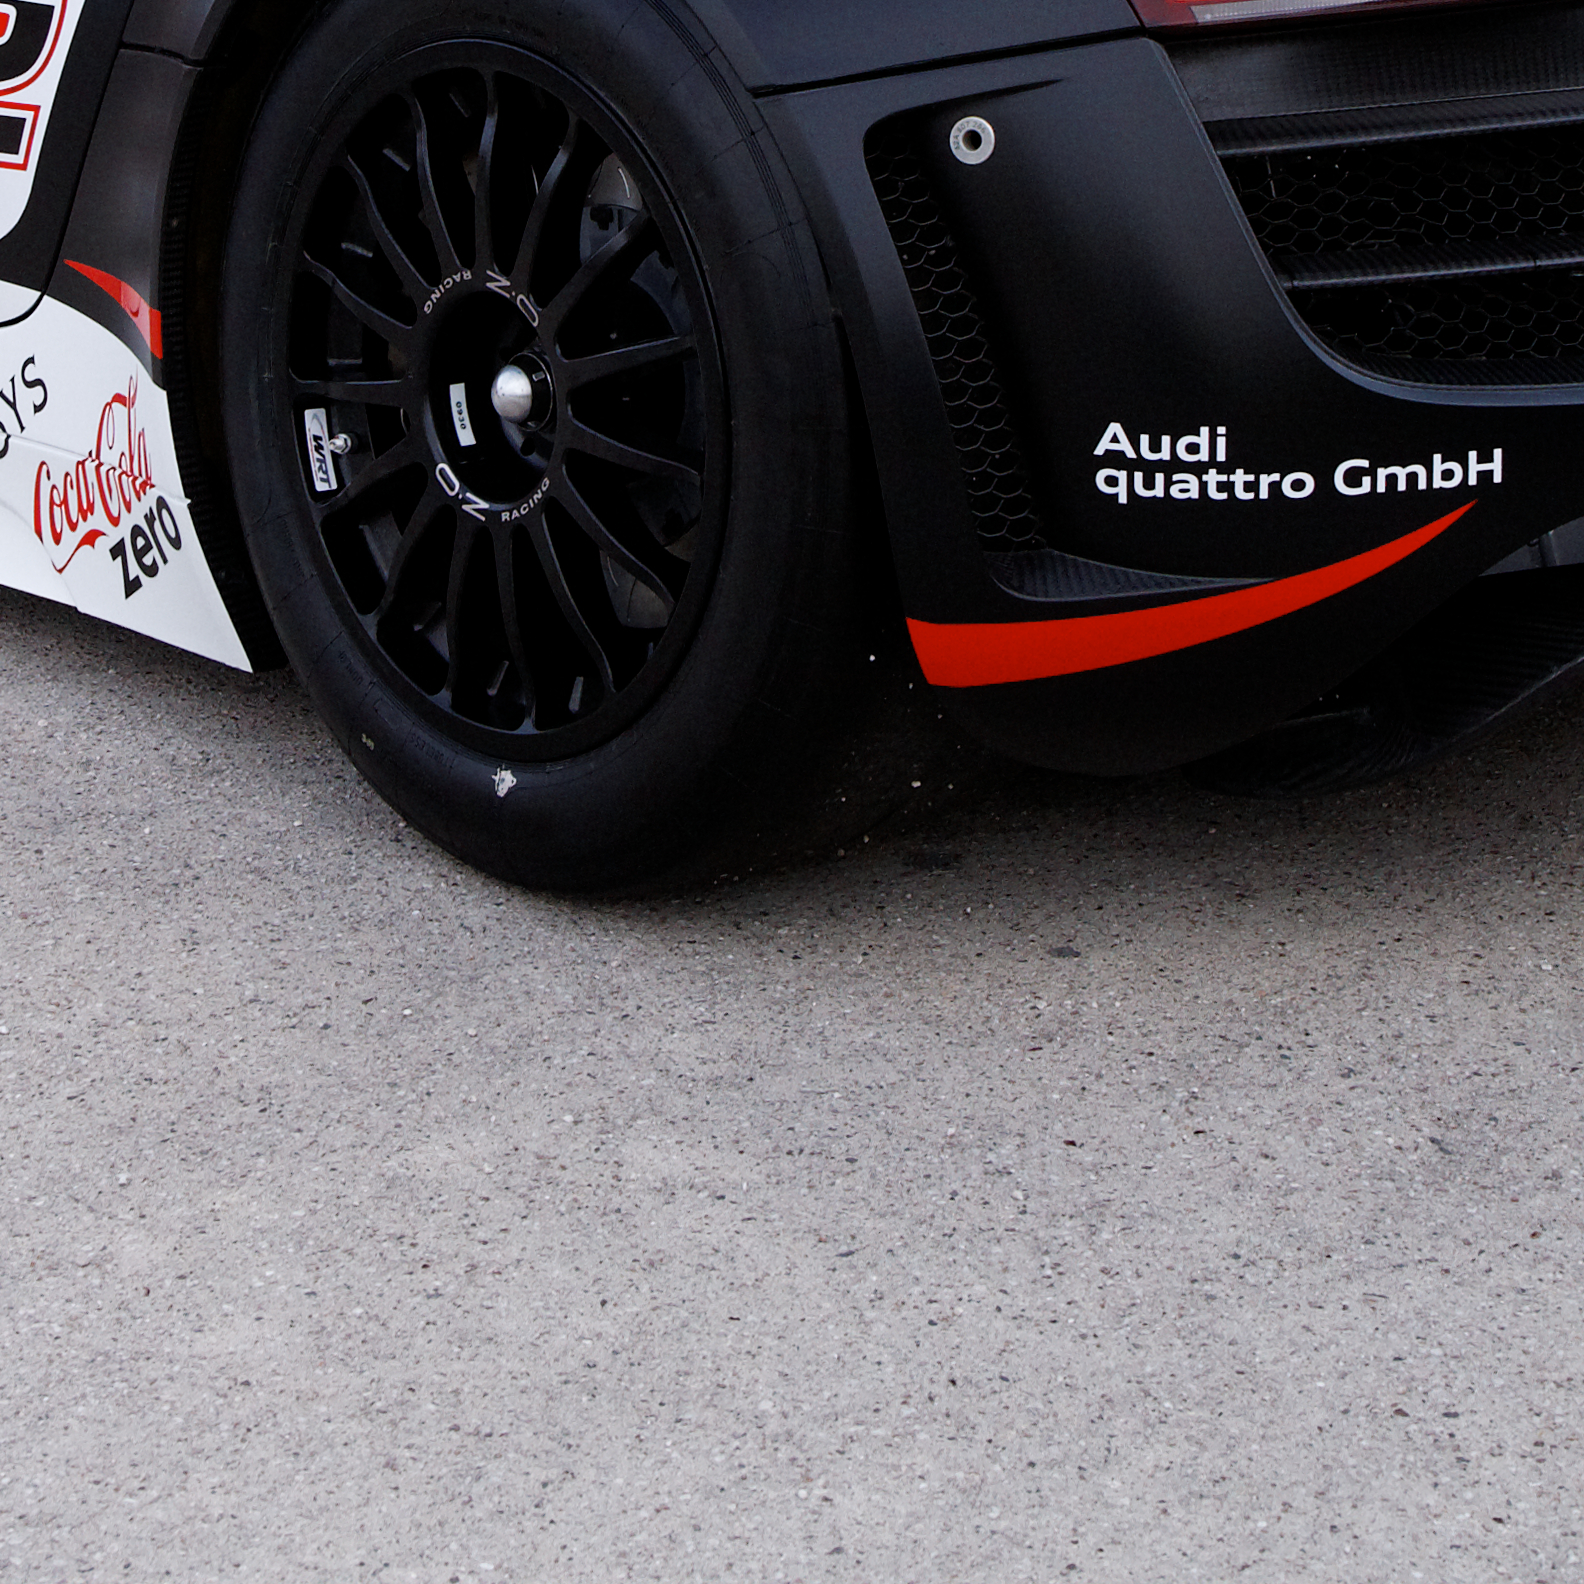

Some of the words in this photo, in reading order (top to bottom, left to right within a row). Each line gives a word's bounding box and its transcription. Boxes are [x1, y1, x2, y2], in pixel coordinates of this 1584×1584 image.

[423, 270, 472, 314] RACING
[456, 401, 467, 430] 0930
[312, 433, 332, 489] WRT
[1092, 421, 1227, 462] Audi
[1094, 466, 1316, 504] quattro
[1333, 447, 1504, 496] GmbH
[501, 476, 551, 522] RACING
[109, 495, 183, 599] zero
